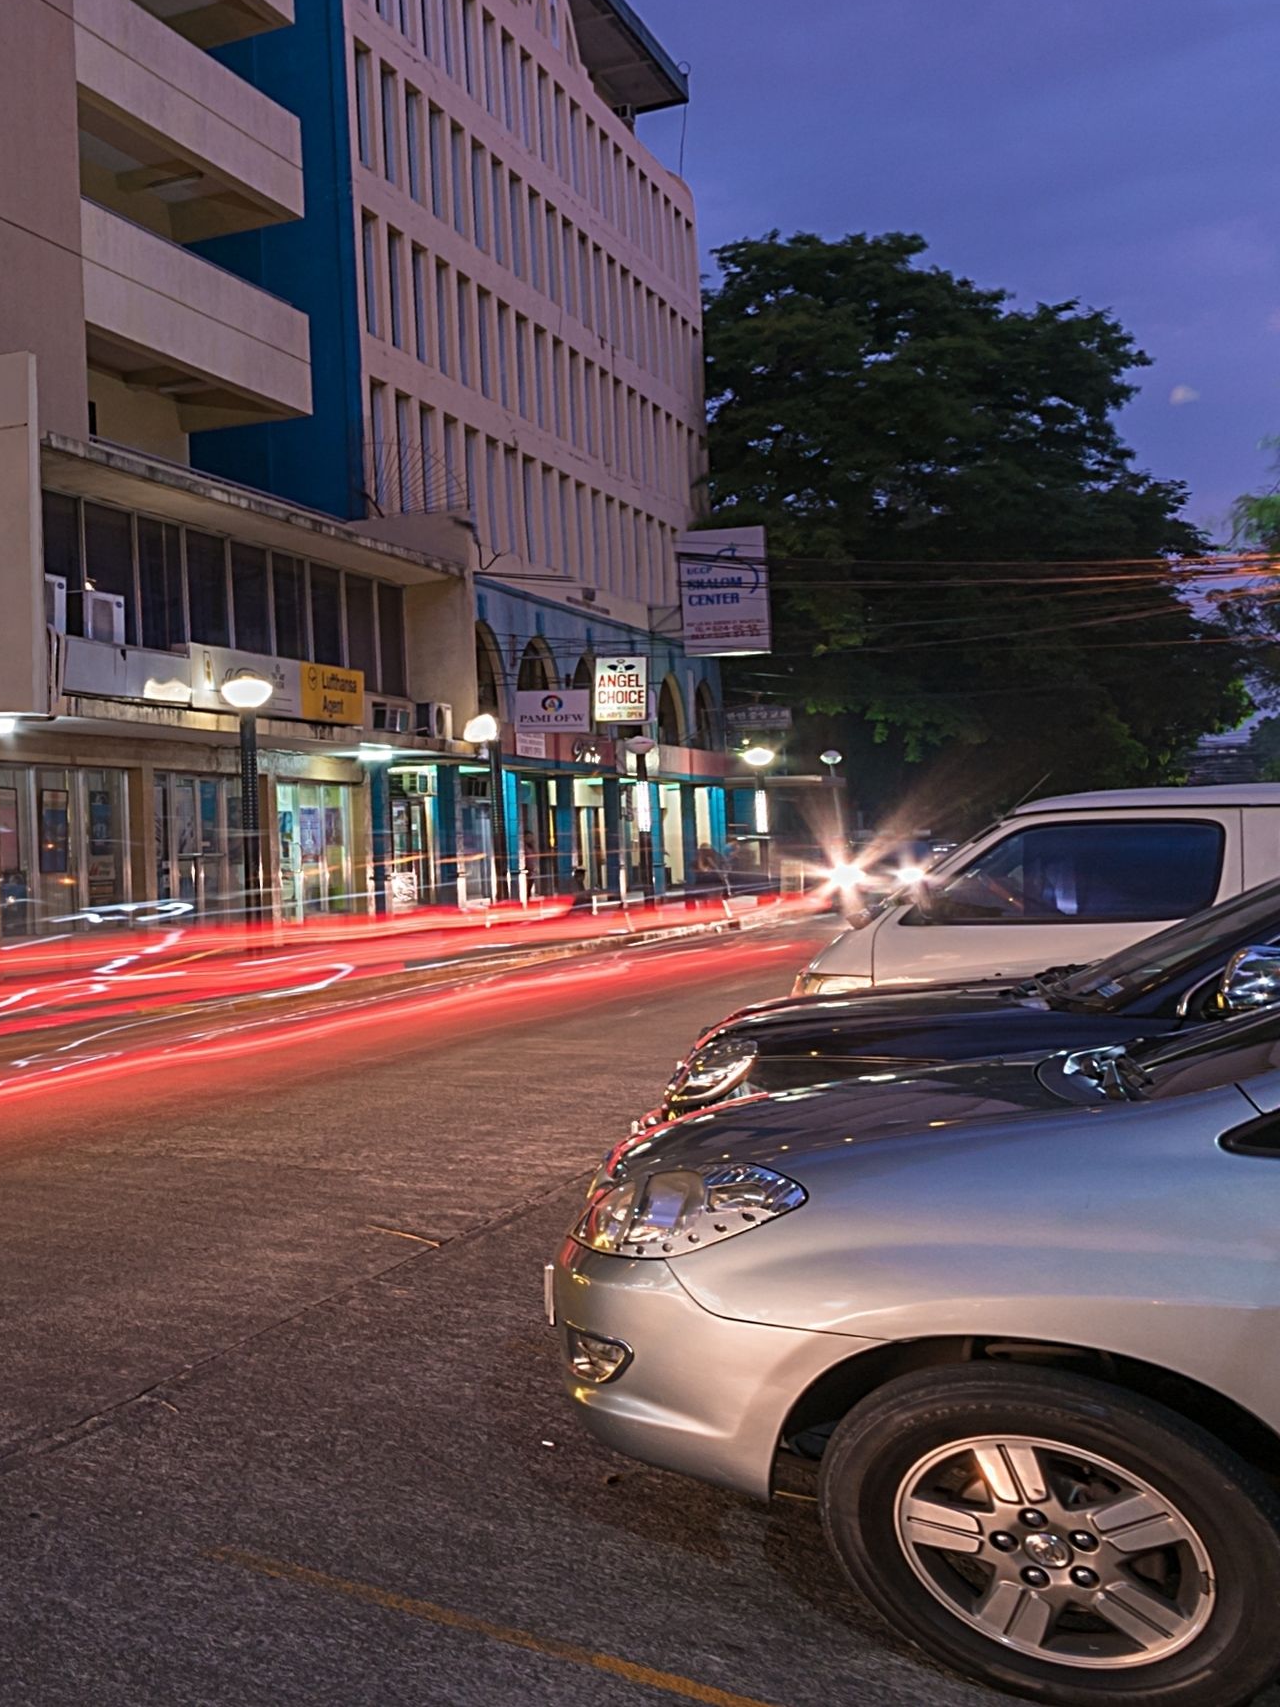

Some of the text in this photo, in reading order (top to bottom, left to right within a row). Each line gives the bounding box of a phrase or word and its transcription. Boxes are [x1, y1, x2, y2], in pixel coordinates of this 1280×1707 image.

[688, 592, 740, 606] CENTER
[322, 671, 357, 693] Lufthansa
[598, 674, 644, 688] ANGEL
[598, 690, 644, 704] CHOICE
[323, 695, 344, 718] Agent
[520, 713, 584, 723] PAMI OFW
